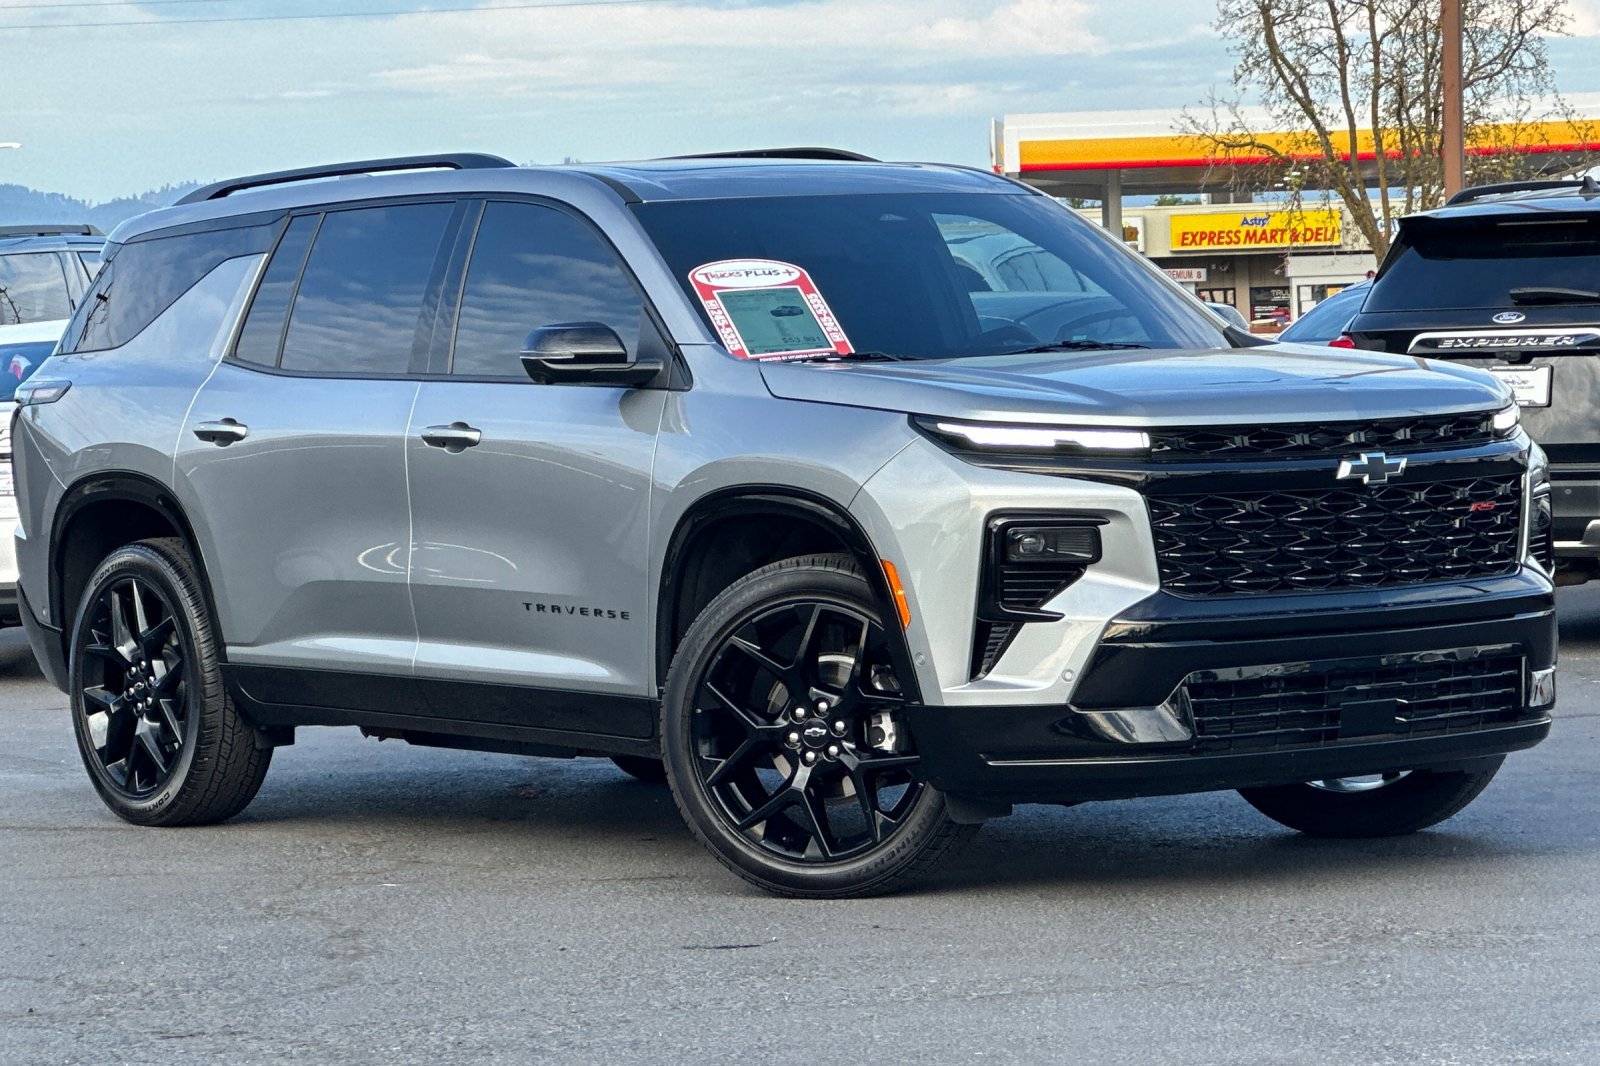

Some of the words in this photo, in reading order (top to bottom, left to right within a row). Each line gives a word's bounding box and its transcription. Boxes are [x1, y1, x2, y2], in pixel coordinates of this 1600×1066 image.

[1181, 230, 1241, 246] EXPRESS
[1243, 228, 1288, 244] MART
[1289, 228, 1300, 242] &
[1303, 227, 1336, 242] DELI
[1438, 336, 1575, 348] EXPLORER
[1469, 501, 1496, 511] RS
[522, 602, 630, 620] TRAVERSE
